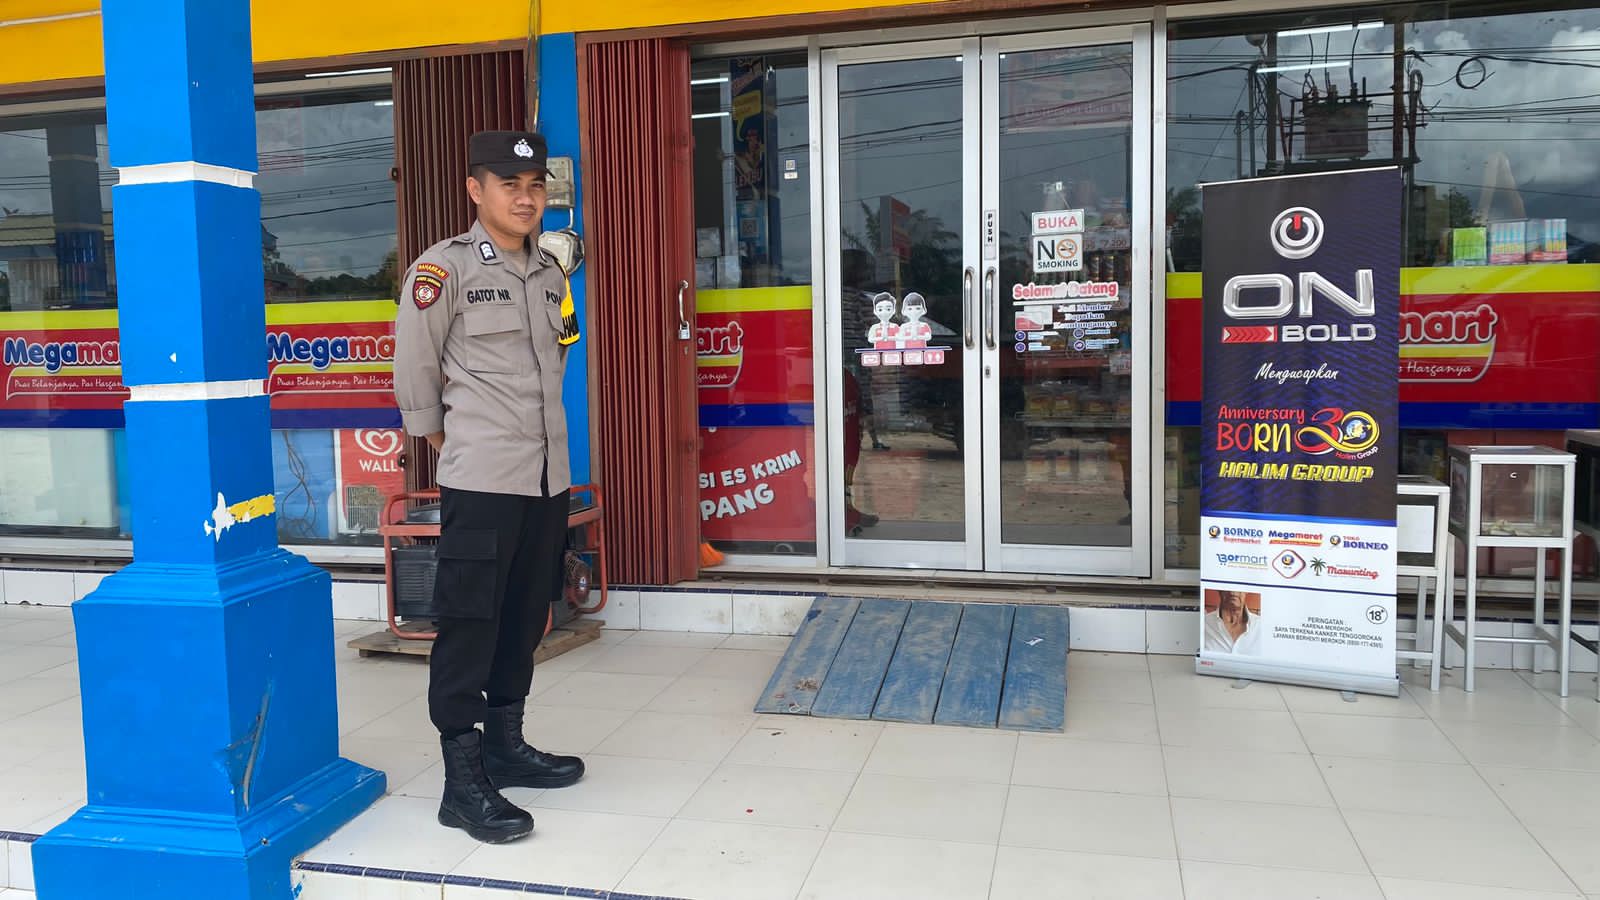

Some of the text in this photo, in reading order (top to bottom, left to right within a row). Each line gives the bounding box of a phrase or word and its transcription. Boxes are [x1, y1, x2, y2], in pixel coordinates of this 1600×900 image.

[1038, 216, 1078, 229] BUKA
[1037, 260, 1079, 269] SMOKING
[467, 289, 511, 304] GATOT NR
[1223, 269, 1376, 320] ON
[1281, 323, 1377, 342] BOLD
[1254, 363, 1339, 385] Mengucapkan
[1408, 361, 1473, 377] Harganya
[1217, 405, 1305, 425] Anniversary
[1215, 422, 1292, 453] BORN
[1356, 446, 1379, 460] Group
[359, 459, 404, 472] WALL
[720, 468, 747, 487] ES
[751, 449, 802, 480] KRIM
[1218, 461, 1375, 483] HALIM GROUP
[700, 483, 775, 521] PANG
[1223, 527, 1264, 538] BORNEO
[1268, 529, 1323, 542] Megamaret
[1343, 541, 1389, 551] BORNEO
[1307, 617, 1344, 626] PERINGATAN
[1315, 630, 1338, 638] KANKER
[1339, 632, 1383, 641] TENGGOROKAN
[1321, 637, 1346, 645] MEROKOK
